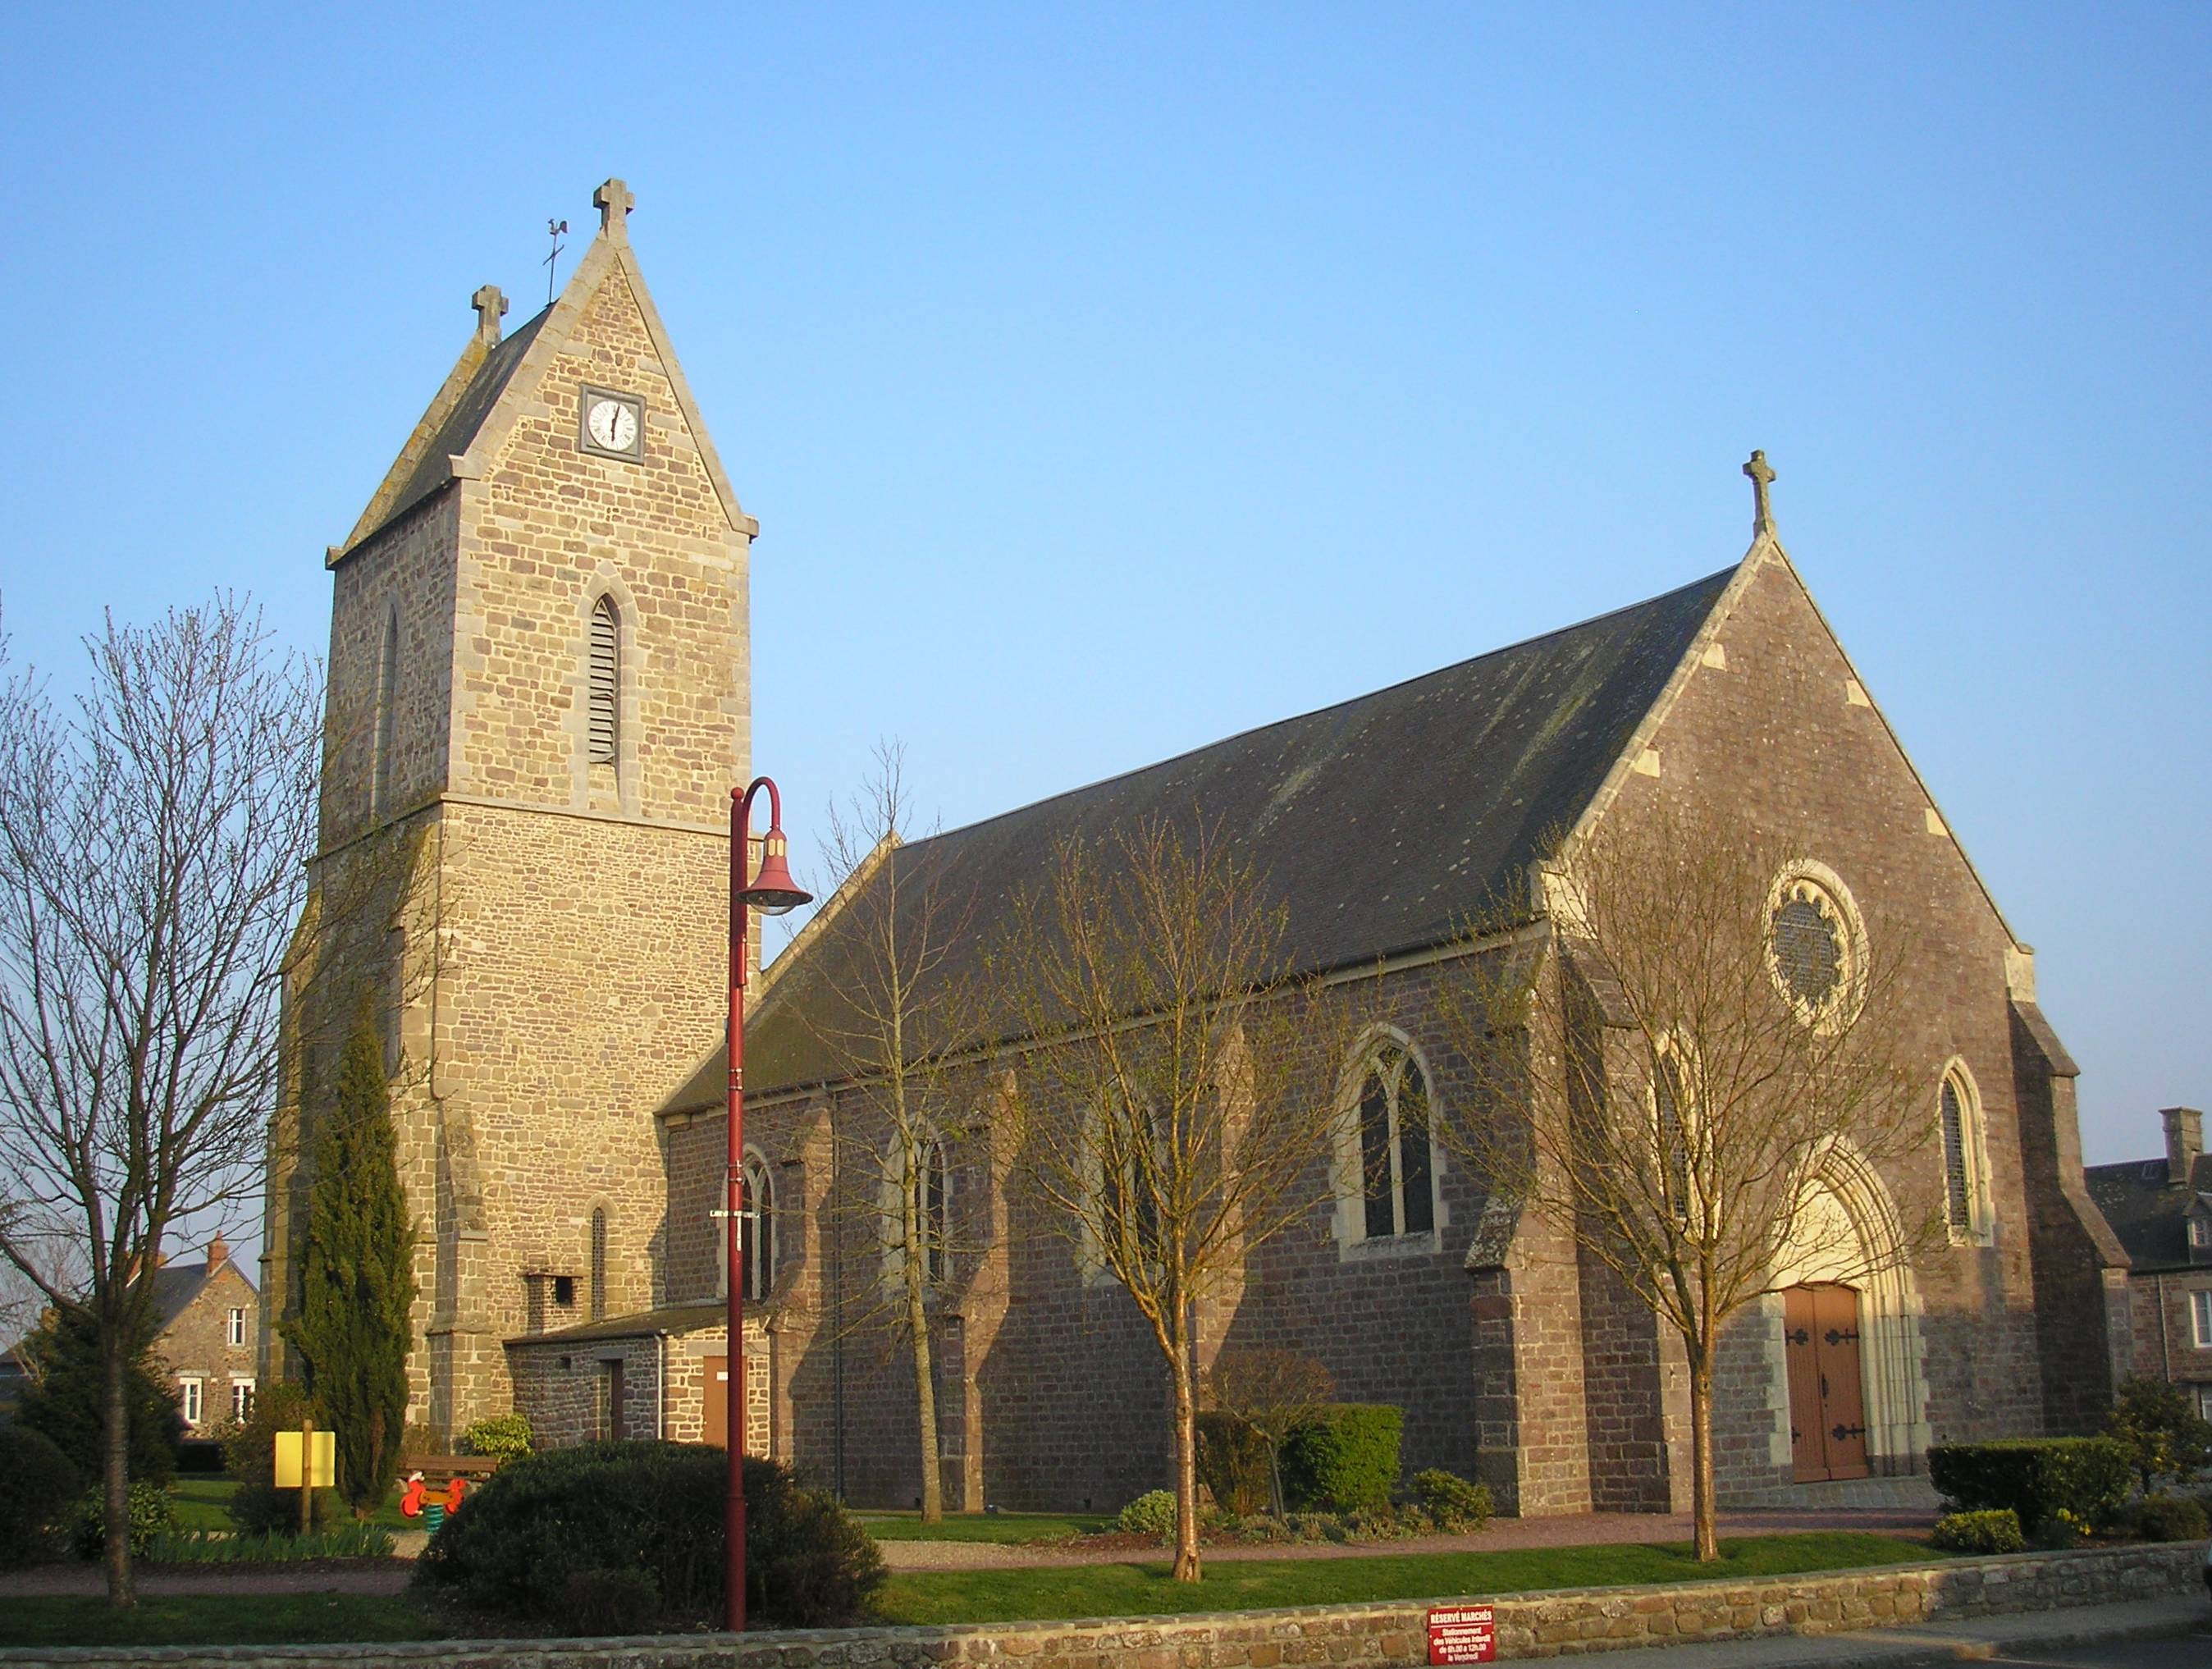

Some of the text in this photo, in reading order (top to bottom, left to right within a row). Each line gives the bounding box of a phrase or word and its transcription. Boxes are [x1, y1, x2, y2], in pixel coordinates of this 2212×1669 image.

[1430, 1609, 1492, 1624] RÉSERVÉ MARCHÉS
[1442, 1626, 1482, 1636] Stationnement
[1438, 1646, 1446, 1654] de
[1454, 1652, 1478, 1662] Vendredi
